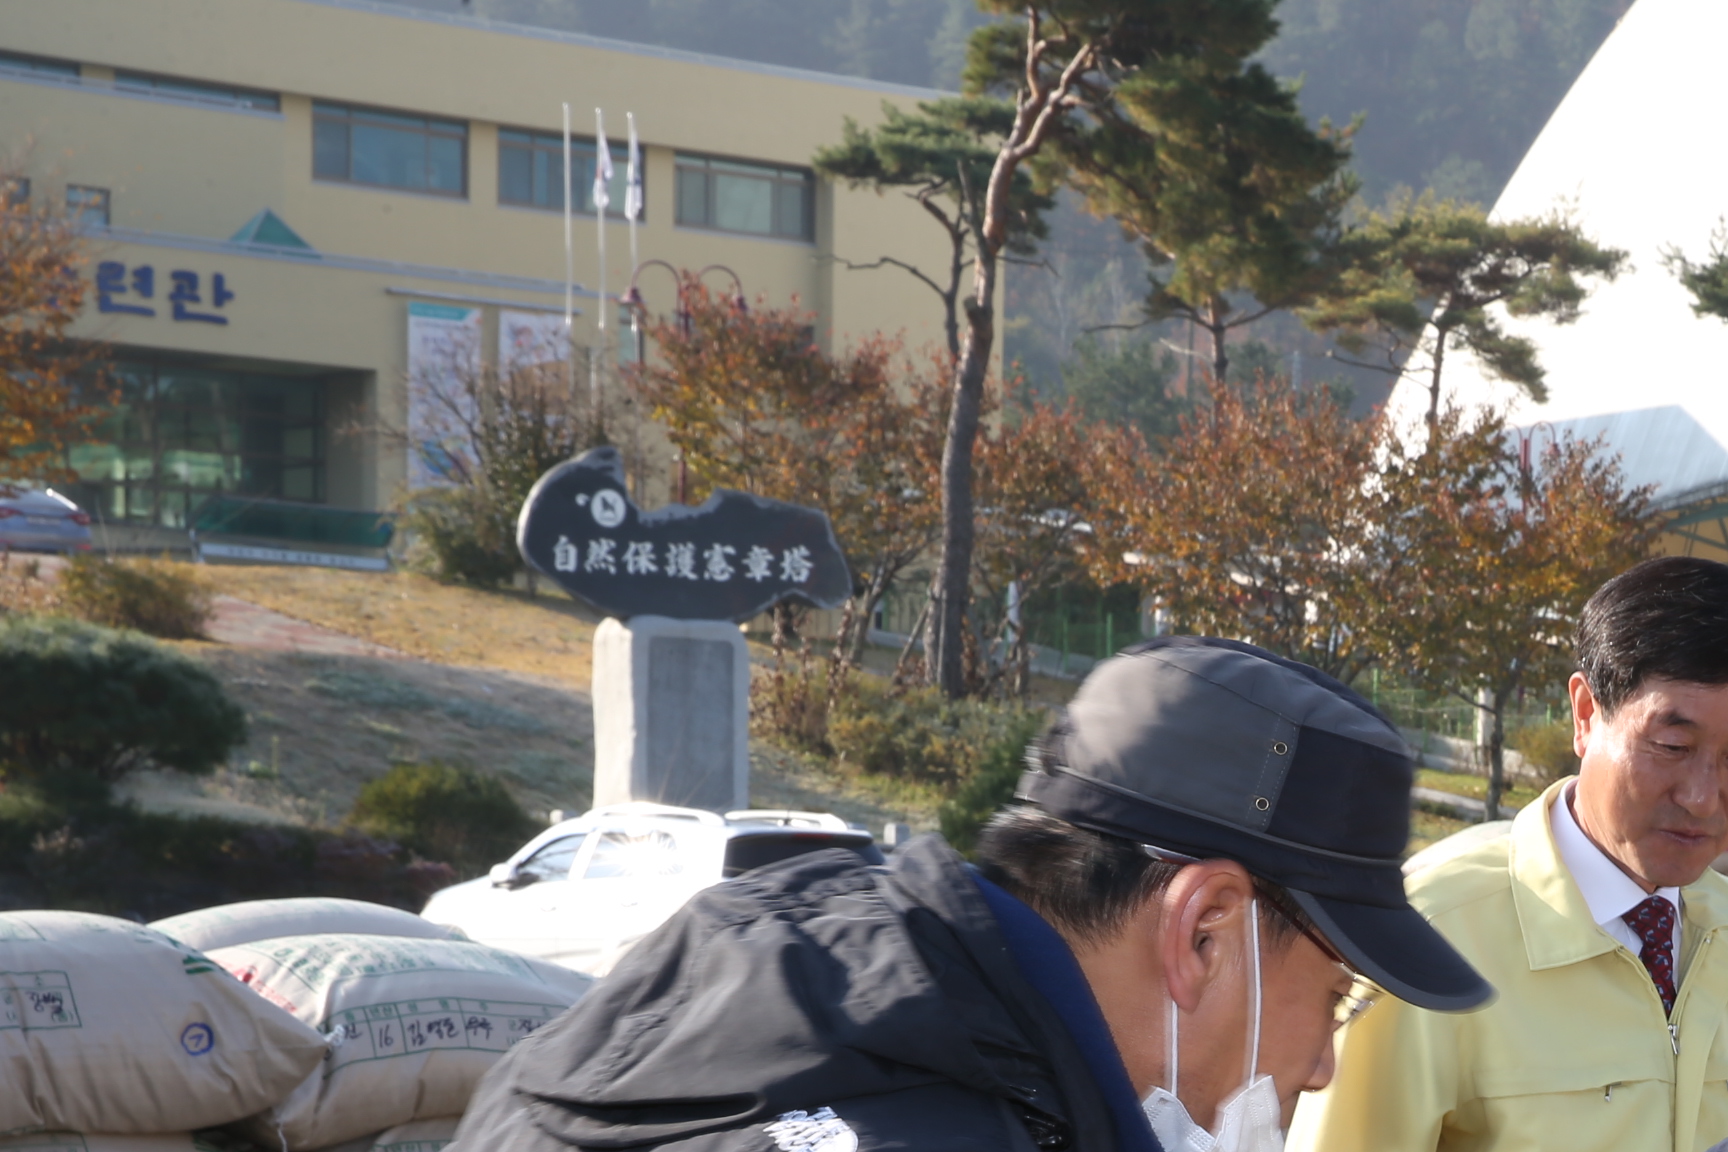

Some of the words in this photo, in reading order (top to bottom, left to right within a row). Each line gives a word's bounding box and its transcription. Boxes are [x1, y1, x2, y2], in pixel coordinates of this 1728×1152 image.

[66, 261, 235, 325] 련관
[553, 535, 813, 583] 自然保護憲章塔
